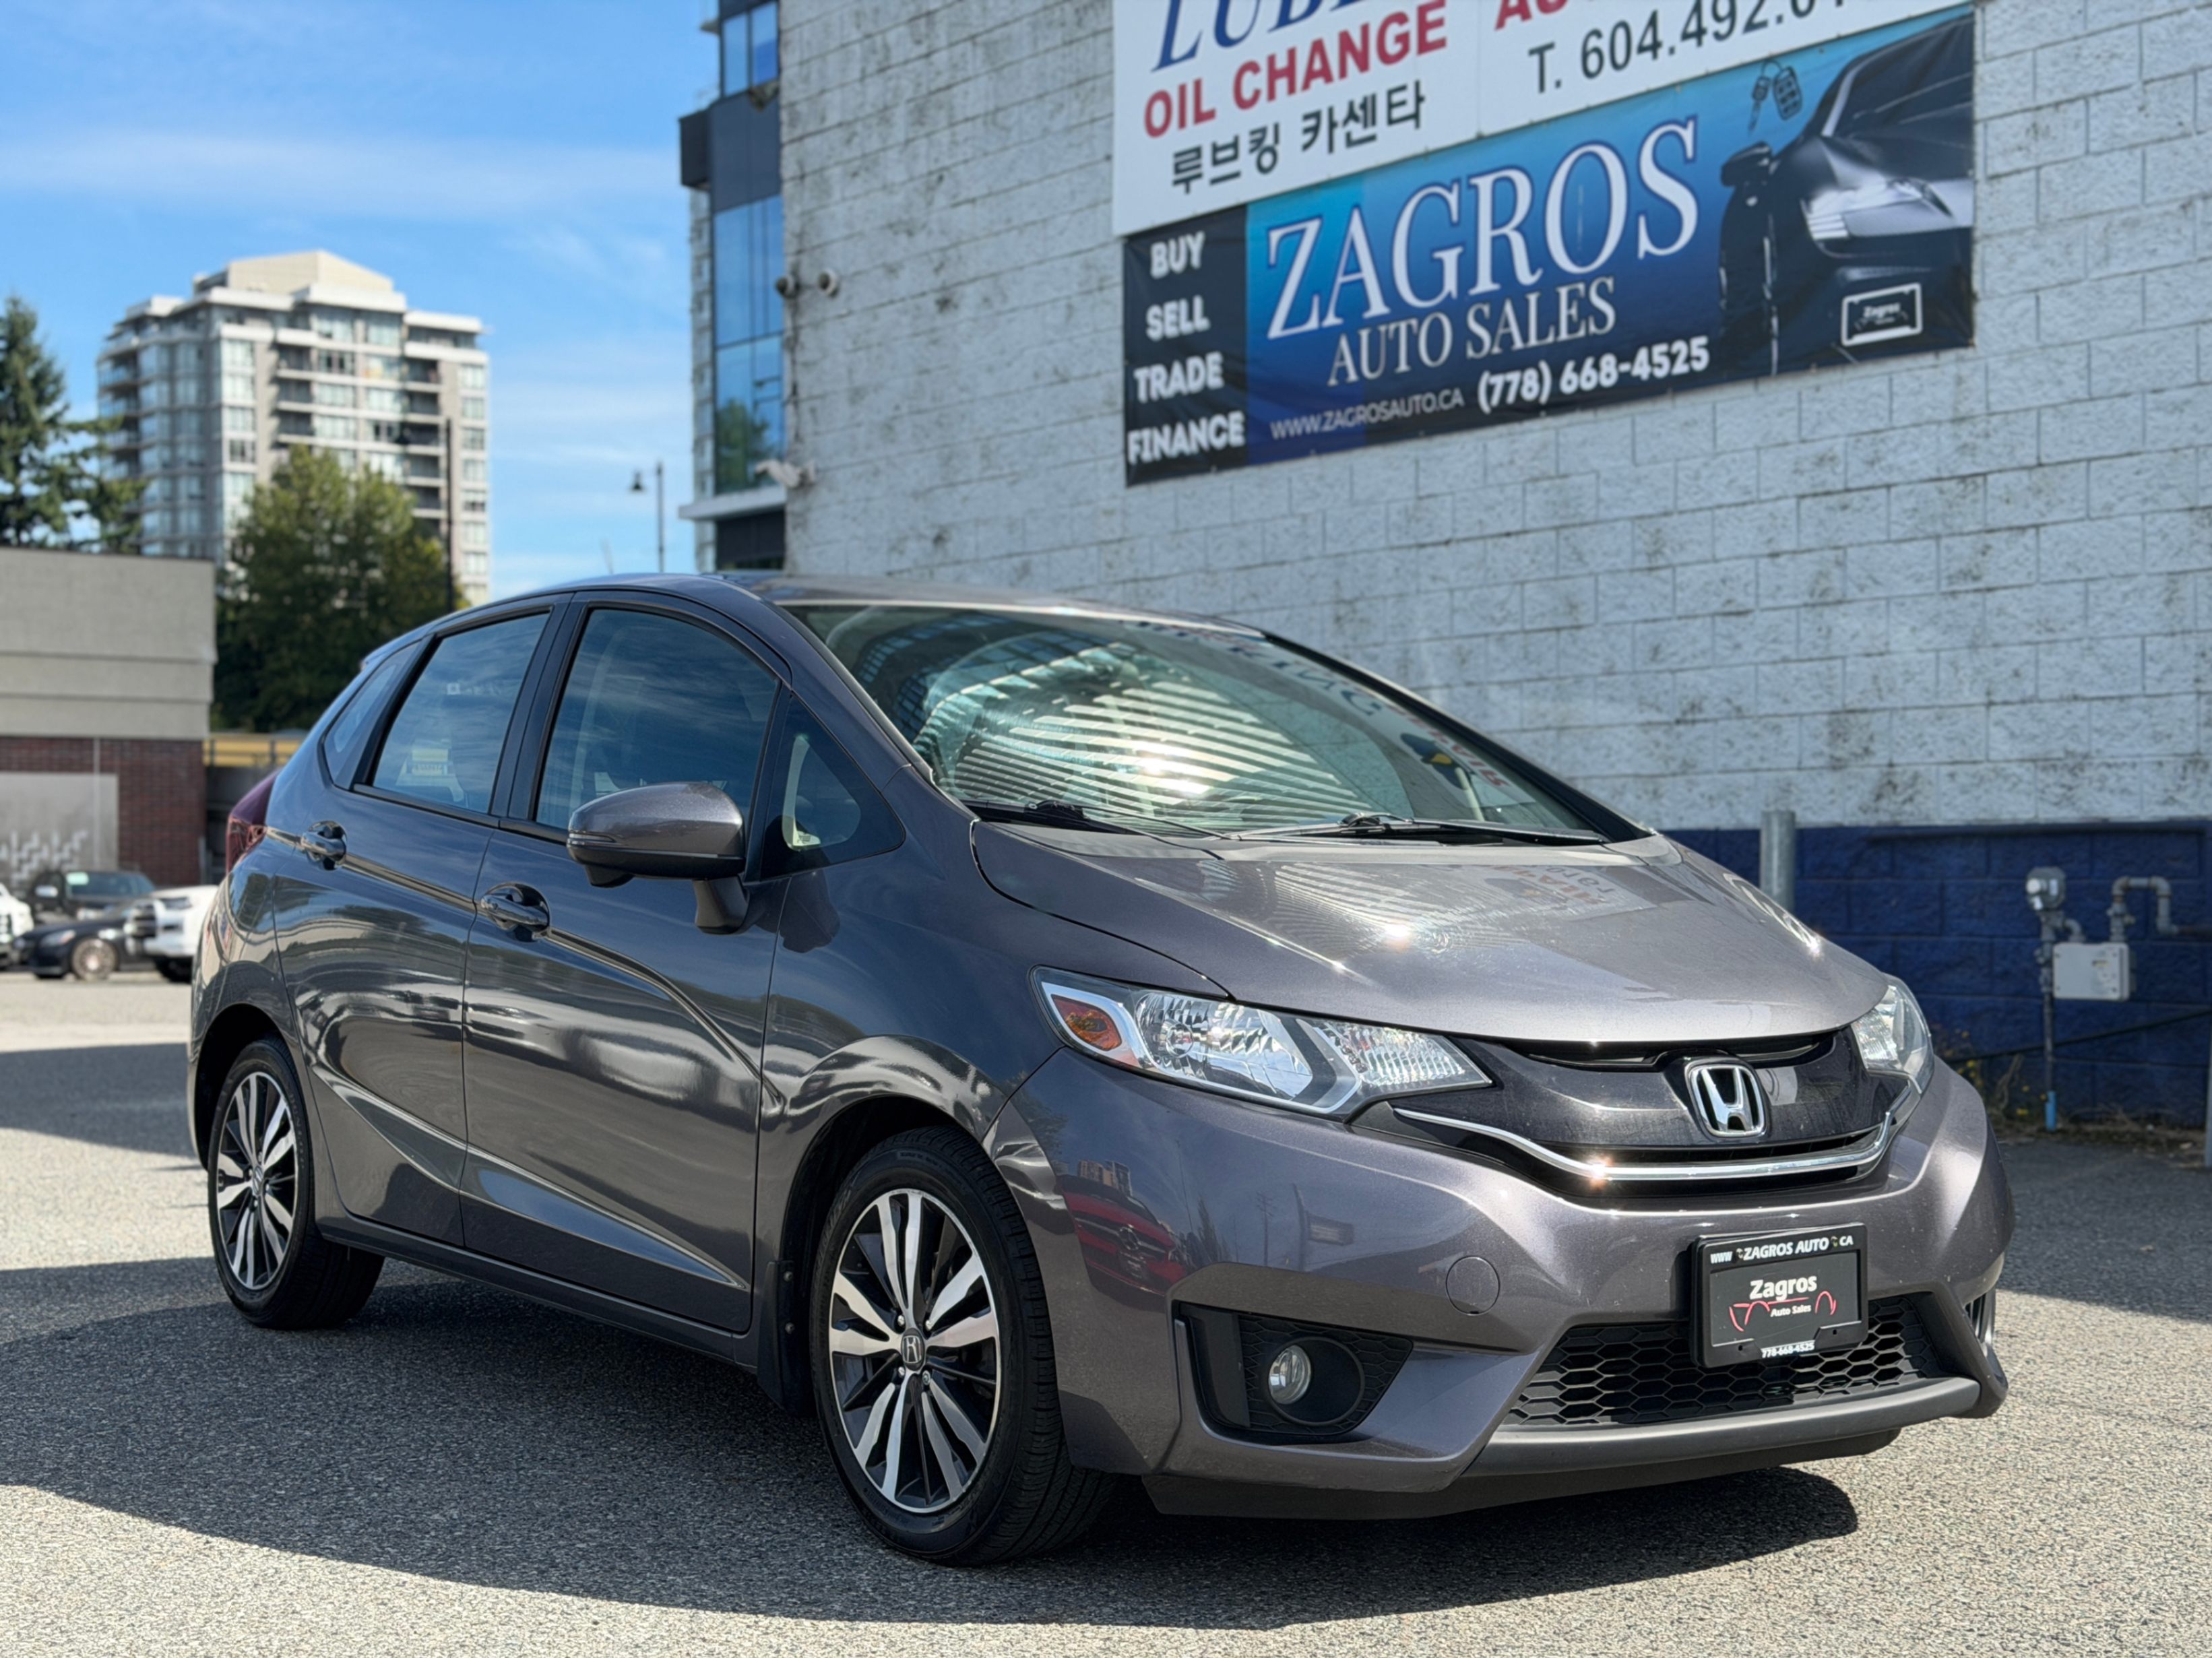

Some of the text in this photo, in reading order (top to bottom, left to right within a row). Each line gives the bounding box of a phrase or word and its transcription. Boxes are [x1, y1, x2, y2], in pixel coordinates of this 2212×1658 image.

[1144, 0, 1447, 139] OIL CHANGE
[1528, 41, 1561, 94] T.
[1172, 79, 1426, 194] 루브킹 카센타
[1265, 114, 1699, 341] ZAGROS
[1150, 231, 1205, 280] BUY
[1146, 294, 1211, 342] SELL
[1327, 276, 1617, 387] AUTO SALES
[1133, 351, 1224, 404] TRADE
[1478, 337, 1710, 414] (778) 668-4525
[1127, 410, 1246, 466] FINANCE
[1270, 388, 1465, 441] WWW.ZAGROSAUTO.CA
[1743, 1242, 1794, 1261] ZAGROS
[1795, 1237, 1829, 1254] AUTO
[1839, 1235, 1854, 1246] CA
[1749, 1275, 1818, 1301] Zagros
[1770, 1304, 1812, 1318] Auto Sales
